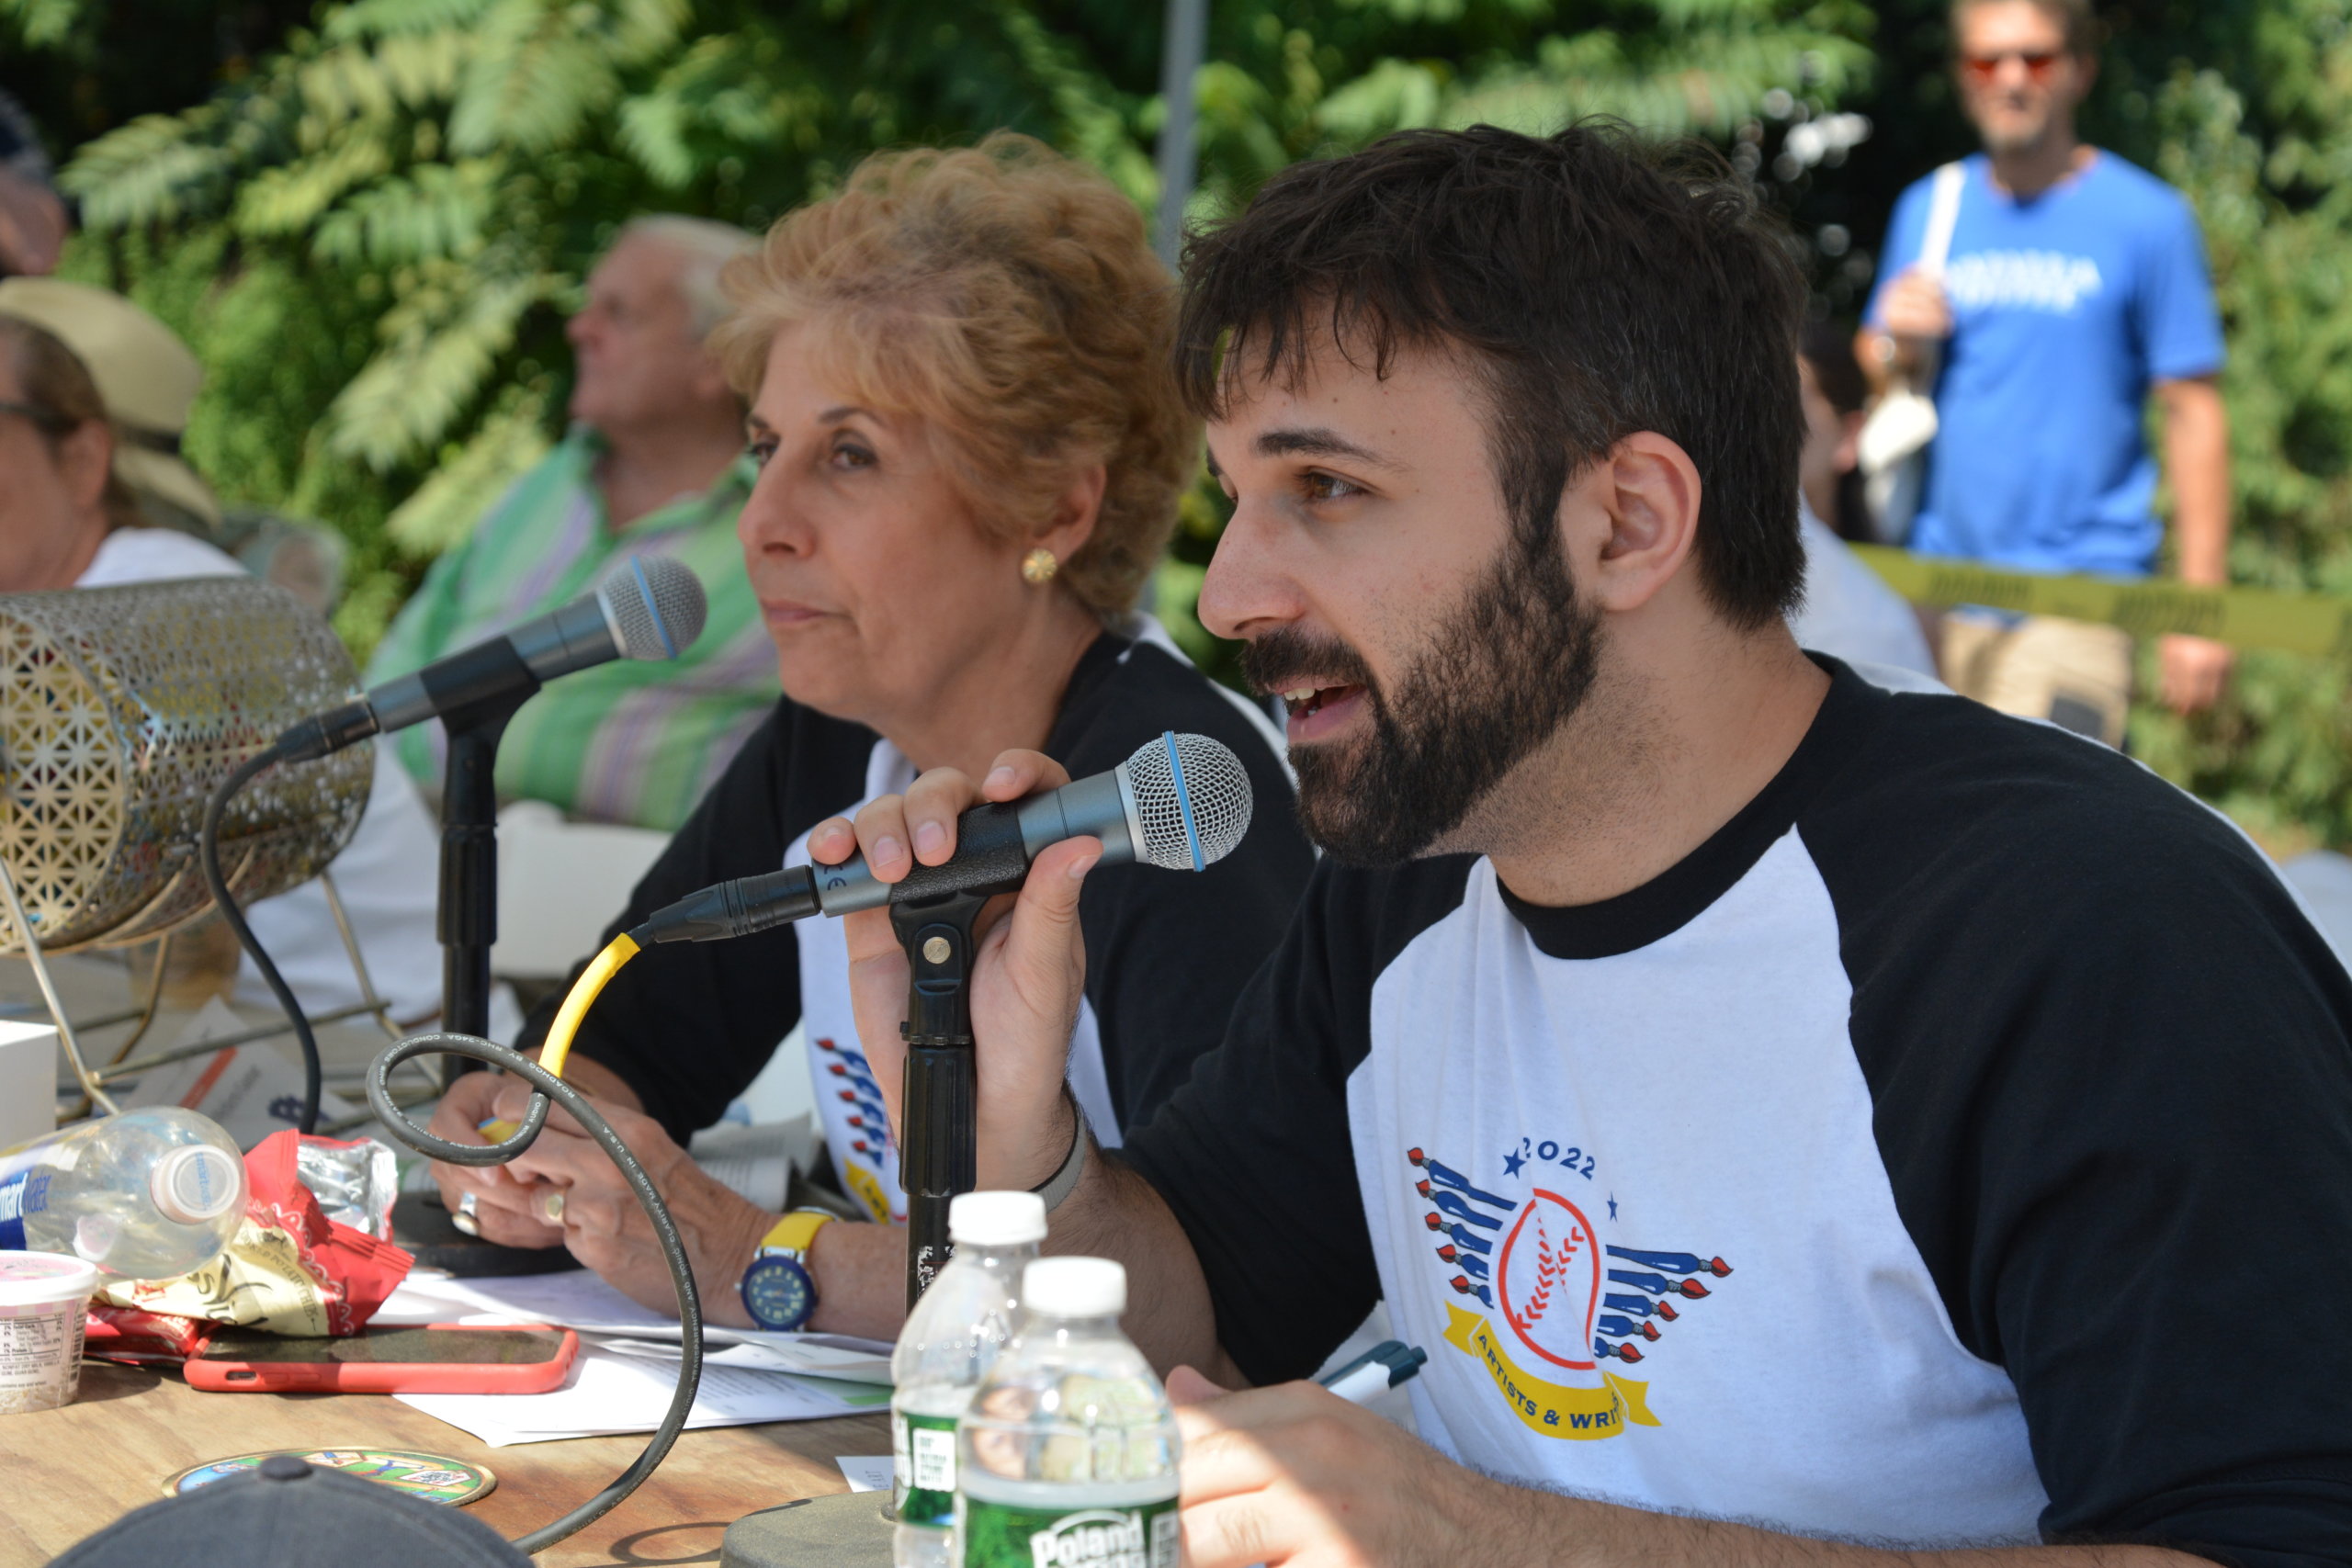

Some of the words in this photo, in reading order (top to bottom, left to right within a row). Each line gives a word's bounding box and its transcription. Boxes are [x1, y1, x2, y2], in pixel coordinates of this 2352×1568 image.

[384, 1034, 441, 1063] CONDUCTORS
[508, 1052, 523, 1062] BY
[528, 1062, 576, 1099] ROADHOG
[528, 1101, 541, 1123] AUDIO
[626, 1156, 636, 1168] IN
[637, 1171, 656, 1200] MADE
[654, 1201, 675, 1243] CLARITY
[673, 1247, 687, 1277] SONIC
[684, 1282, 695, 1301] AND
[690, 1307, 701, 1382] TRANSPARENCY
[1477, 1334, 1537, 1416] ARTISTS
[1544, 1413, 1560, 1427] &
[1029, 1509, 1146, 1568] Poland
